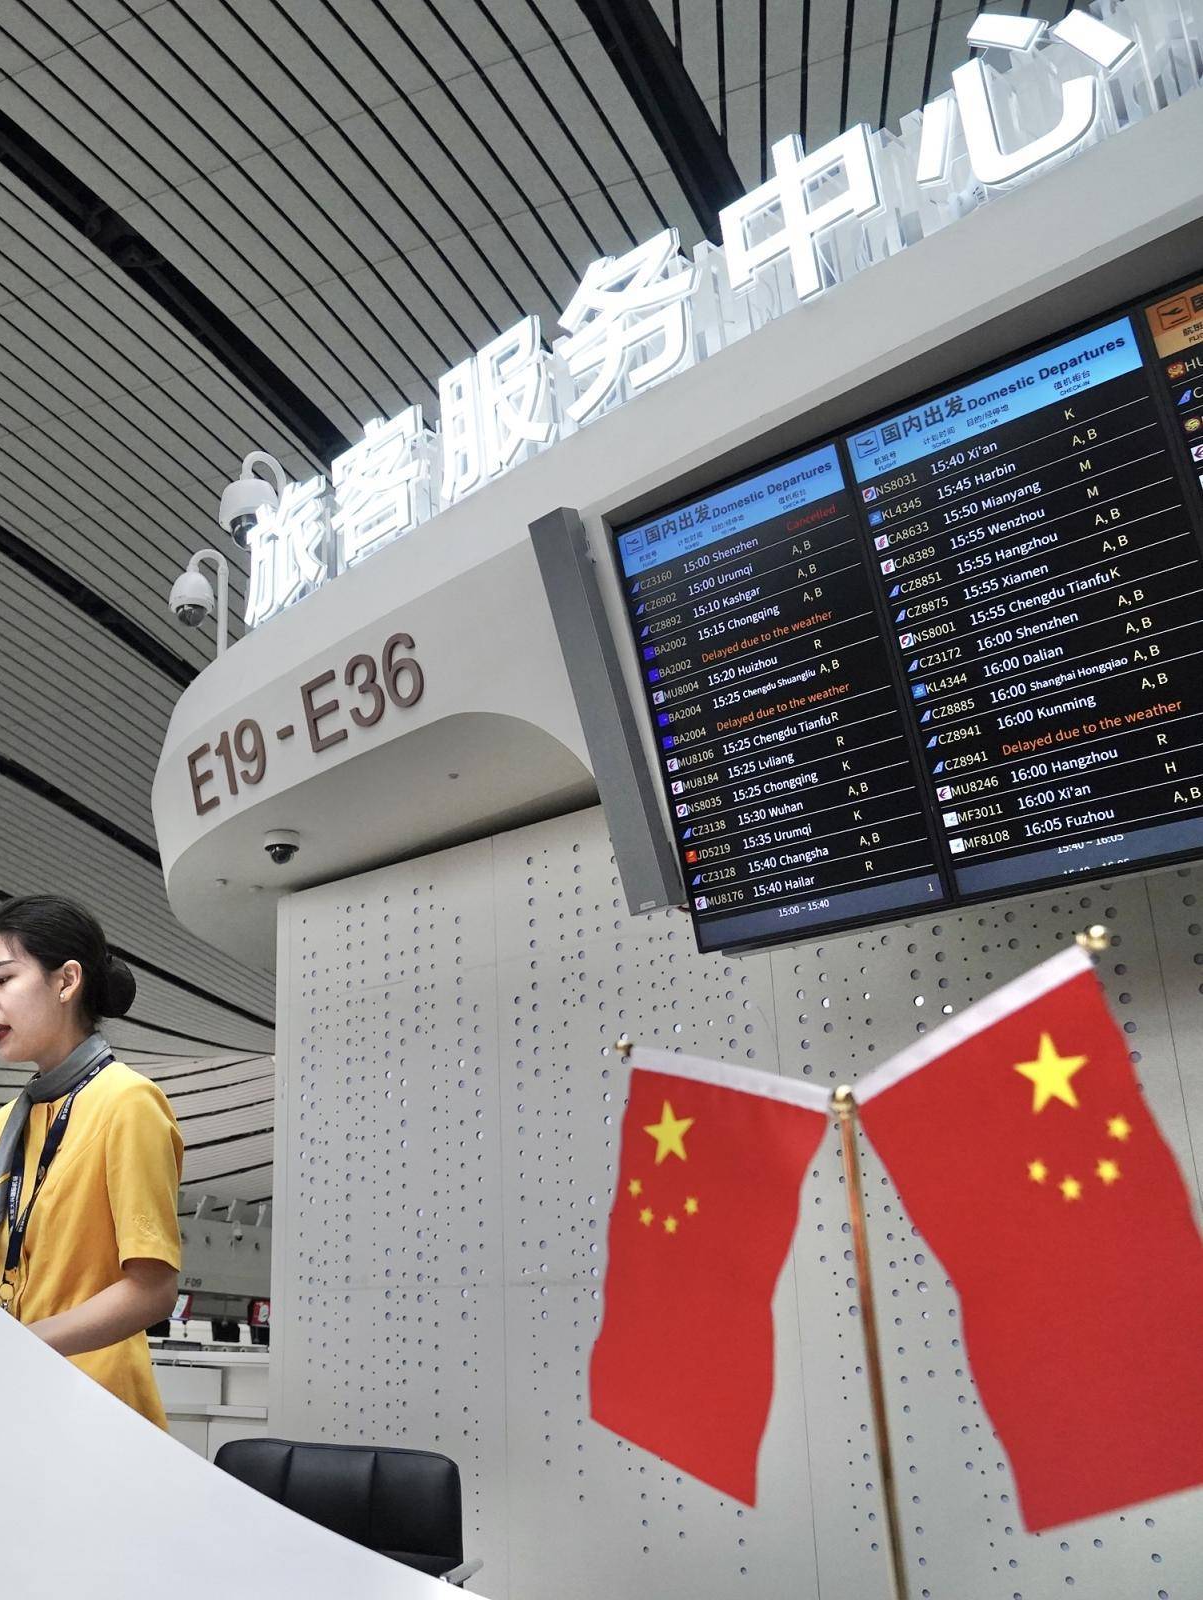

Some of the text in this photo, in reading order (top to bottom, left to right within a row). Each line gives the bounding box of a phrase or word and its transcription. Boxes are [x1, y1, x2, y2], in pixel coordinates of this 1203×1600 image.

[245, 8, 1138, 627] 旅客服务中心
[966, 337, 1126, 411] Domestic Departures
[880, 394, 967, 447] 国内出发
[874, 407, 1075, 497] NS8031 15:40 Xi'an K
[711, 461, 832, 519] Domestic Departures
[880, 463, 1016, 521] KL4345 15:45 Harbin
[887, 459, 1092, 545] CA8633 15:50 Mianyang M
[639, 503, 836, 590] CZ3160 15:00 Shenzhen Cancelled
[643, 503, 712, 546] 国内出发
[893, 485, 1099, 569] CA8389 15:55 Wenzhou M
[644, 562, 753, 612] CZ6902 15:00 Urumqi
[899, 532, 1058, 594] CZ8851 15:55 Hangzhou
[906, 564, 1049, 618] CZ8875 15:55 Xiamen
[648, 586, 760, 634] CZ8892 15:10 Kashgar
[653, 605, 780, 657] BA2002 15:15 Chongqing
[912, 566, 1121, 644] NS8001 15:55 Chengdu Tianfu K
[918, 646, 962, 669] CZ3172
[976, 629, 1013, 652] 16:00
[1015, 612, 1079, 639] Shenzhen
[1132, 589, 1144, 601] B
[658, 610, 832, 678] BA2002 Delayed due to the weather
[663, 638, 822, 700] MU8004 15:20 Huizhou R
[924, 646, 1064, 694] KL4344 16:00 Dalian
[667, 668, 816, 723] BA2004 15:25 Chengdu Shuangliu
[672, 683, 849, 746] BA2004 Delayed due to the weather
[931, 657, 1128, 719] CZ8885 16:00 Shanghai Hongqiao
[937, 724, 982, 745] CZ8941
[996, 708, 1034, 730] 16:00
[1036, 695, 1097, 719] Kunming
[1156, 672, 1168, 685] B
[677, 711, 839, 768] MU8106 15:25 Chengdu Tianfu R
[682, 735, 845, 791] MU8184 15:25 Lvliang R
[943, 700, 1182, 771] CZ8941 Delayed due to the weather
[950, 733, 1168, 797] MU8246 16:00 Hangzhou R
[686, 759, 851, 814] NS8035 15:25 Chongqing K
[691, 819, 727, 837] CZ3138
[737, 808, 767, 826] 15:30
[767, 801, 804, 818] Wuhan
[859, 781, 869, 793] B
[956, 761, 1177, 823] MF3011 16:00 Xi'an H
[696, 809, 863, 860] JD5219 15:35 Urumqi K
[963, 829, 1010, 850] MF8108
[1024, 816, 1063, 837] 16:05
[1065, 808, 1115, 828] Fuzhou
[1189, 786, 1202, 799] B
[700, 866, 737, 883] CZ3128
[747, 856, 777, 874] 15:40
[778, 846, 829, 866] Changsha
[871, 832, 880, 843] B
[705, 860, 874, 907] MU8176 15:40 Hailar R
[778, 898, 830, 918] 15:00 15:40
